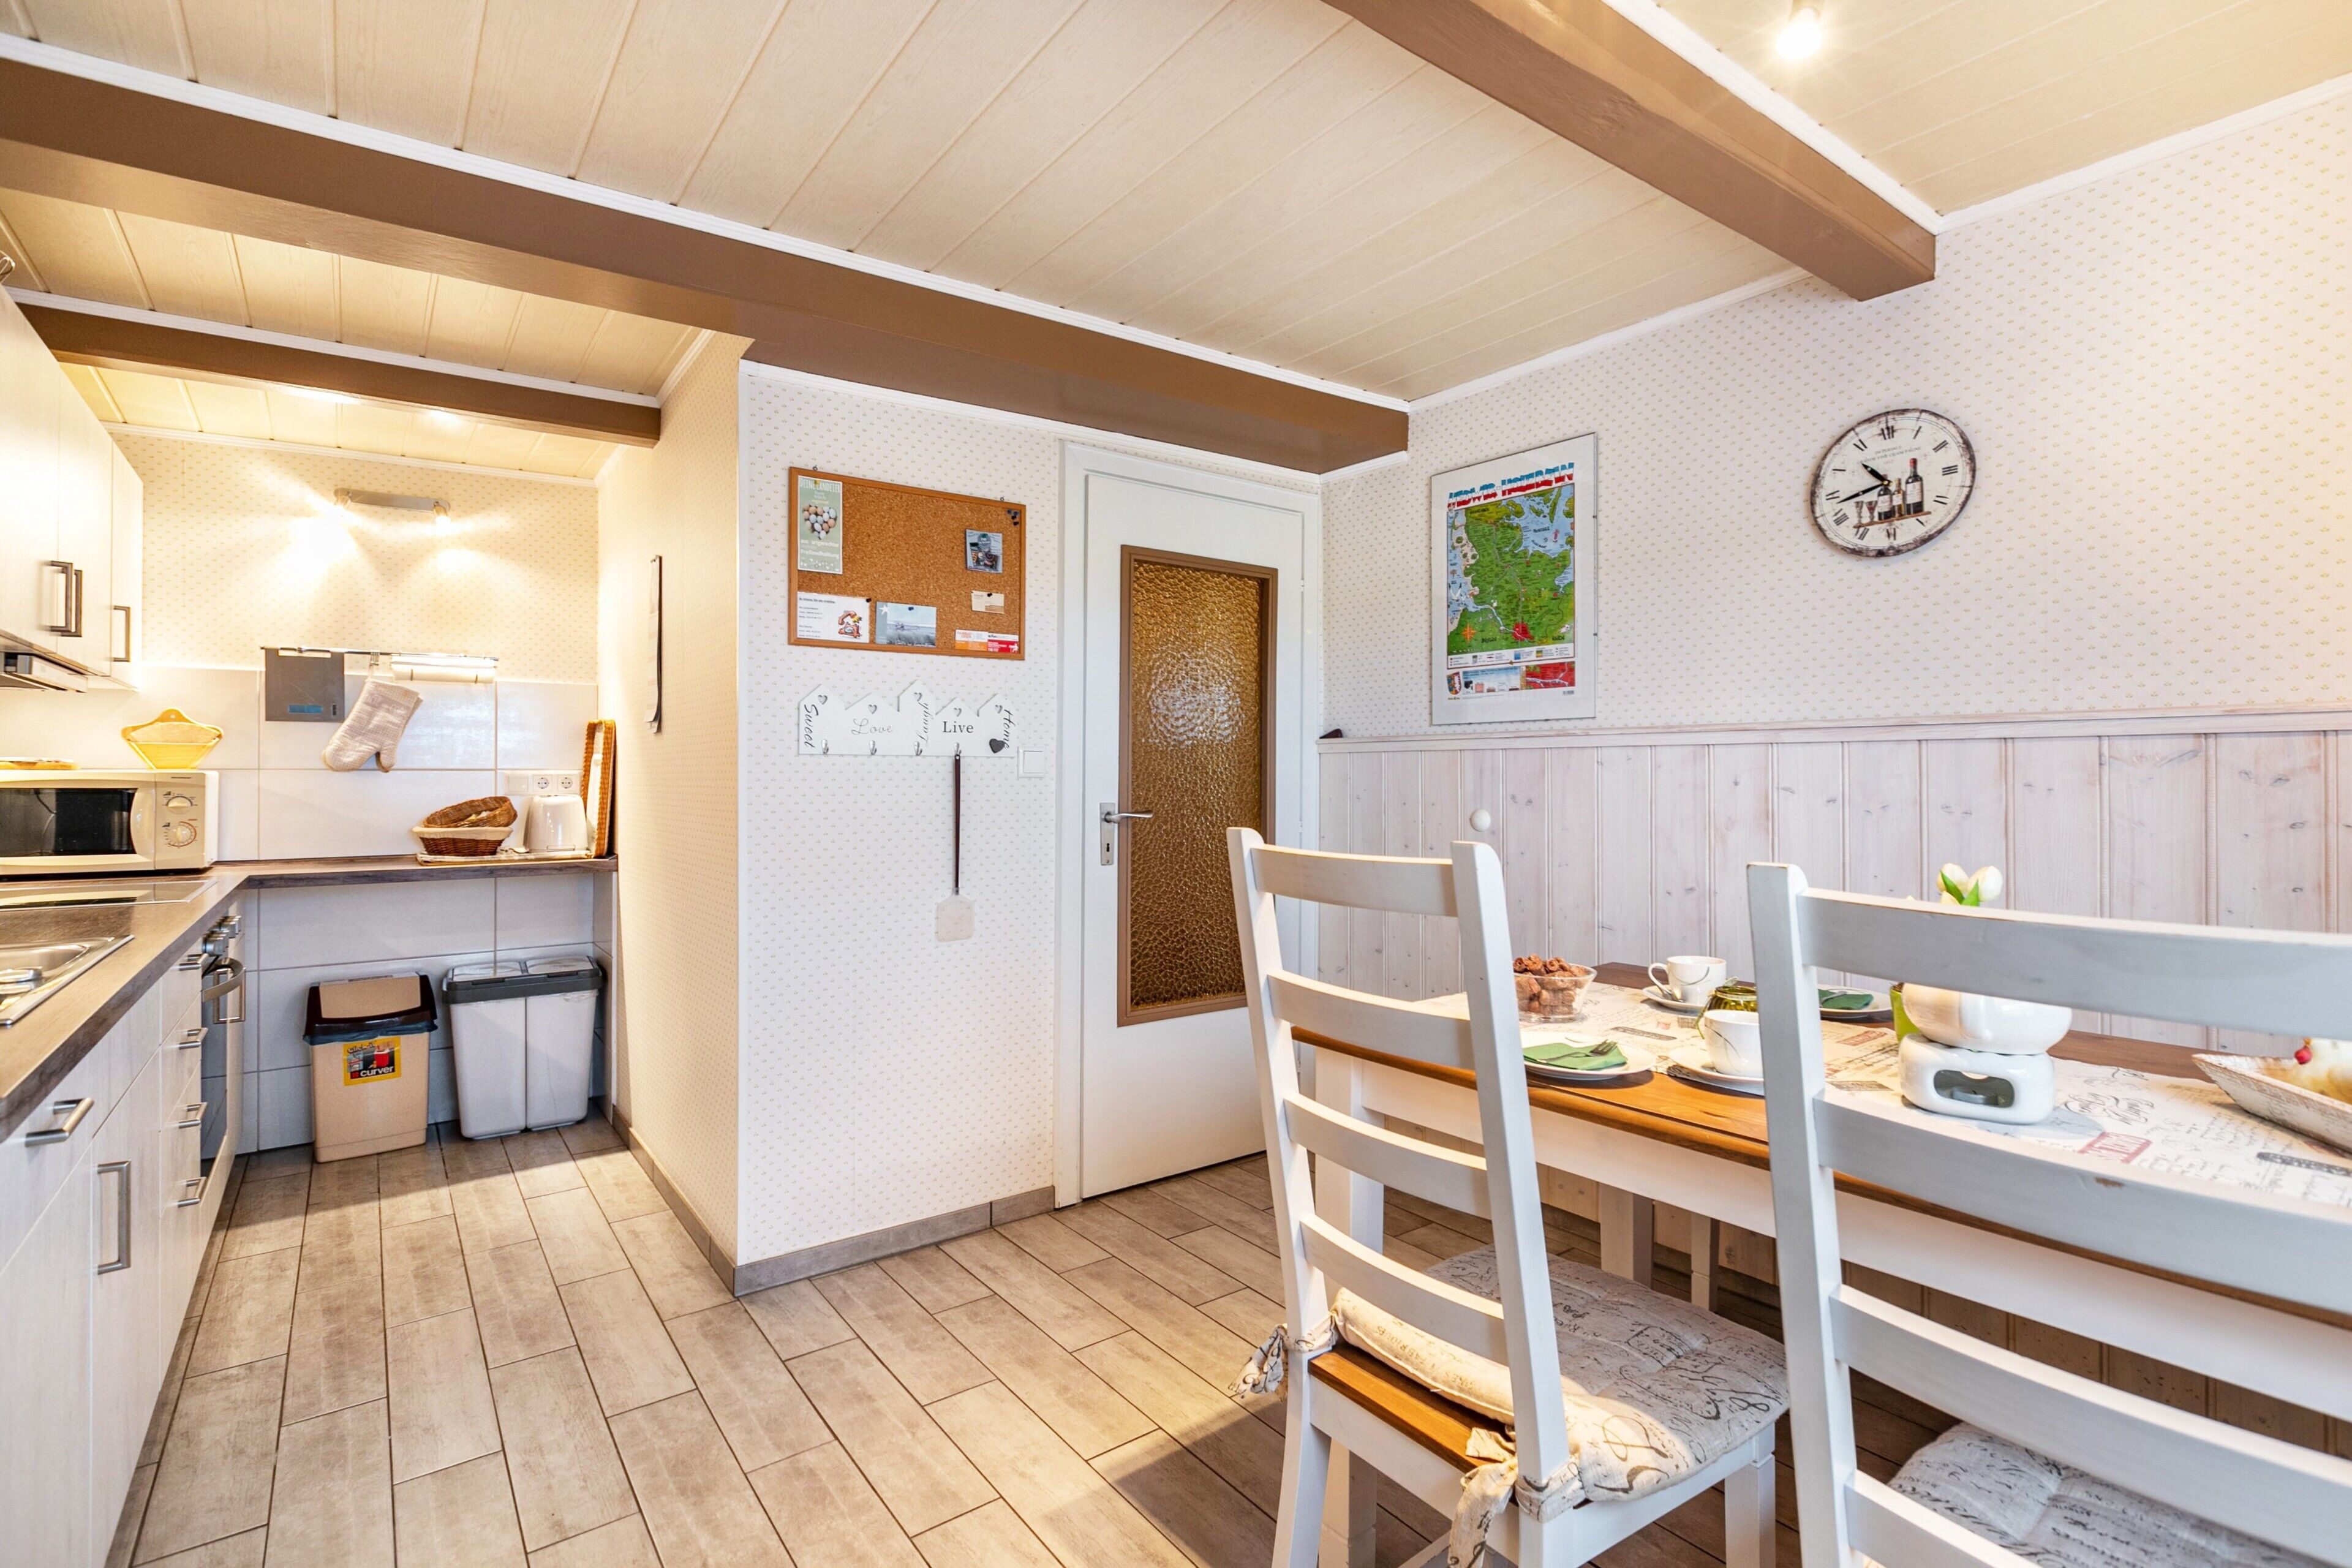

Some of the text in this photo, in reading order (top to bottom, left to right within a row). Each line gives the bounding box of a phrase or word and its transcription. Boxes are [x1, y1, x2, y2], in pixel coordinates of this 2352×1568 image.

[804, 704, 819, 748] Sweet
[851, 718, 893, 736] Love
[916, 702, 934, 746] Laugh
[942, 721, 974, 734] Live
[1003, 709, 1016, 749] Home
[360, 1066, 394, 1077] curver
